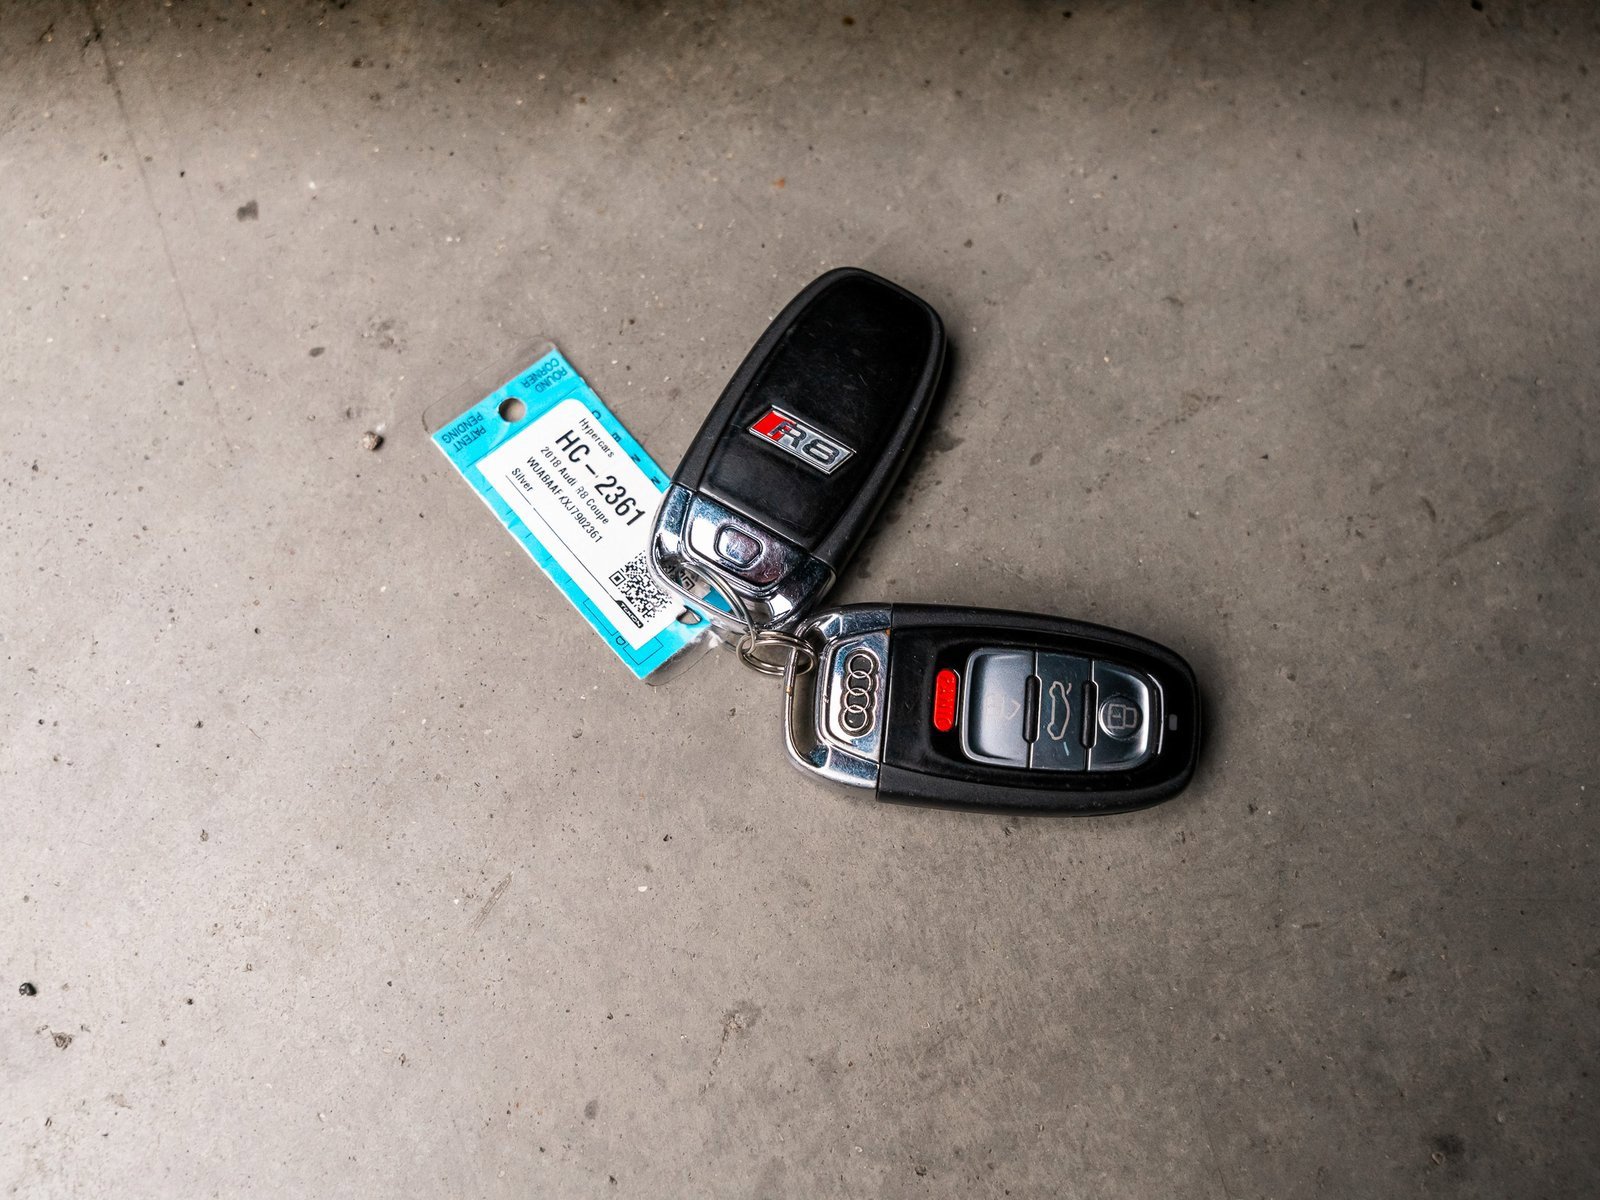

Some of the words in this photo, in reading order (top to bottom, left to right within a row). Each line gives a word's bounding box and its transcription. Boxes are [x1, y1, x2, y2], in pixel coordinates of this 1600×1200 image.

[520, 358, 560, 388] CORNER
[534, 370, 568, 393] ROUND
[441, 412, 484, 444] PENDING
[454, 425, 487, 453] PATENT
[579, 417, 615, 459] Hypercars
[767, 420, 840, 465] R8
[511, 467, 534, 492] Silver
[540, 446, 559, 468] 2018
[558, 466, 578, 487] Audi
[575, 486, 588, 499] R8
[586, 498, 610, 525] Coupe
